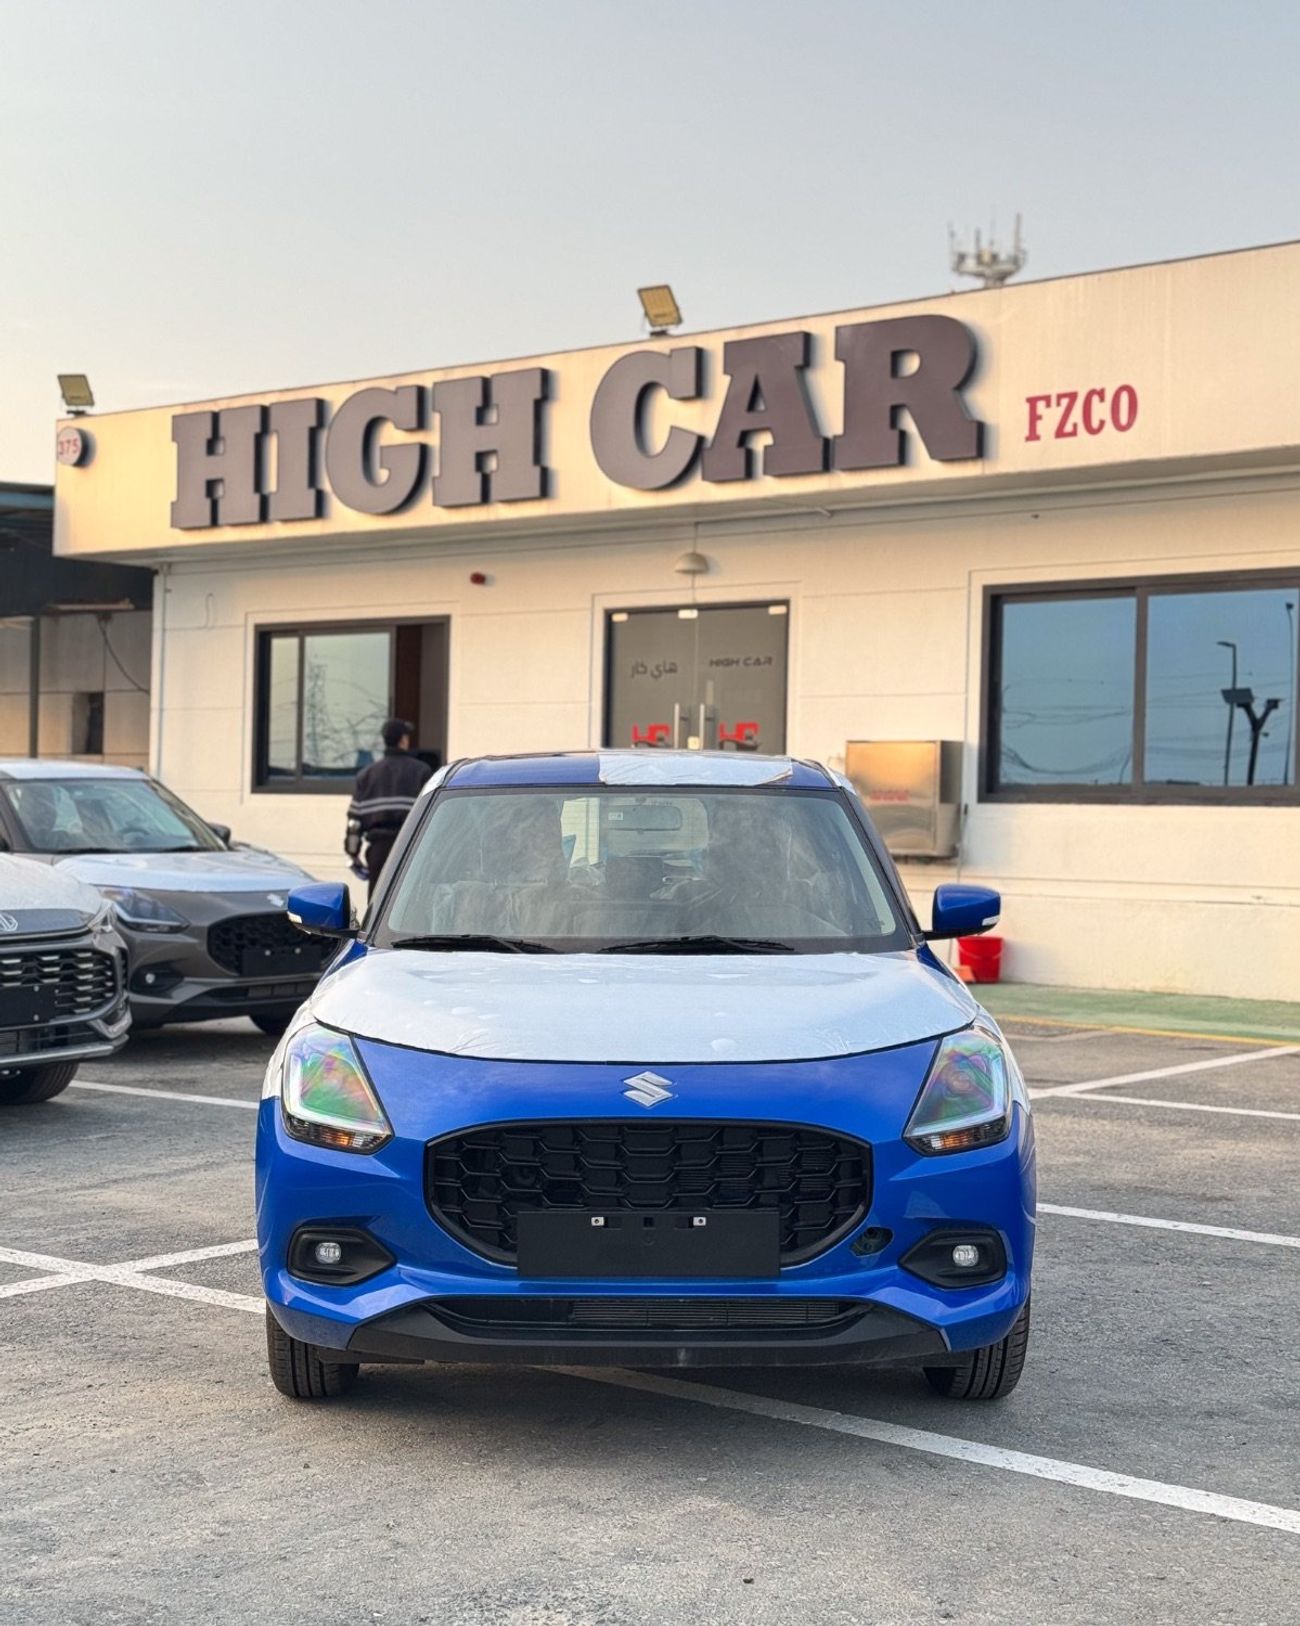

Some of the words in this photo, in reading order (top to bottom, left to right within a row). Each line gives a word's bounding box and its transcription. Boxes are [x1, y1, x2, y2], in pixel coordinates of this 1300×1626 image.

[171, 368, 553, 529] HIGH
[590, 314, 984, 489] CAR
[1025, 384, 1138, 442] FZCO
[709, 657, 740, 668] HIGH
[742, 655, 773, 667] CAR
